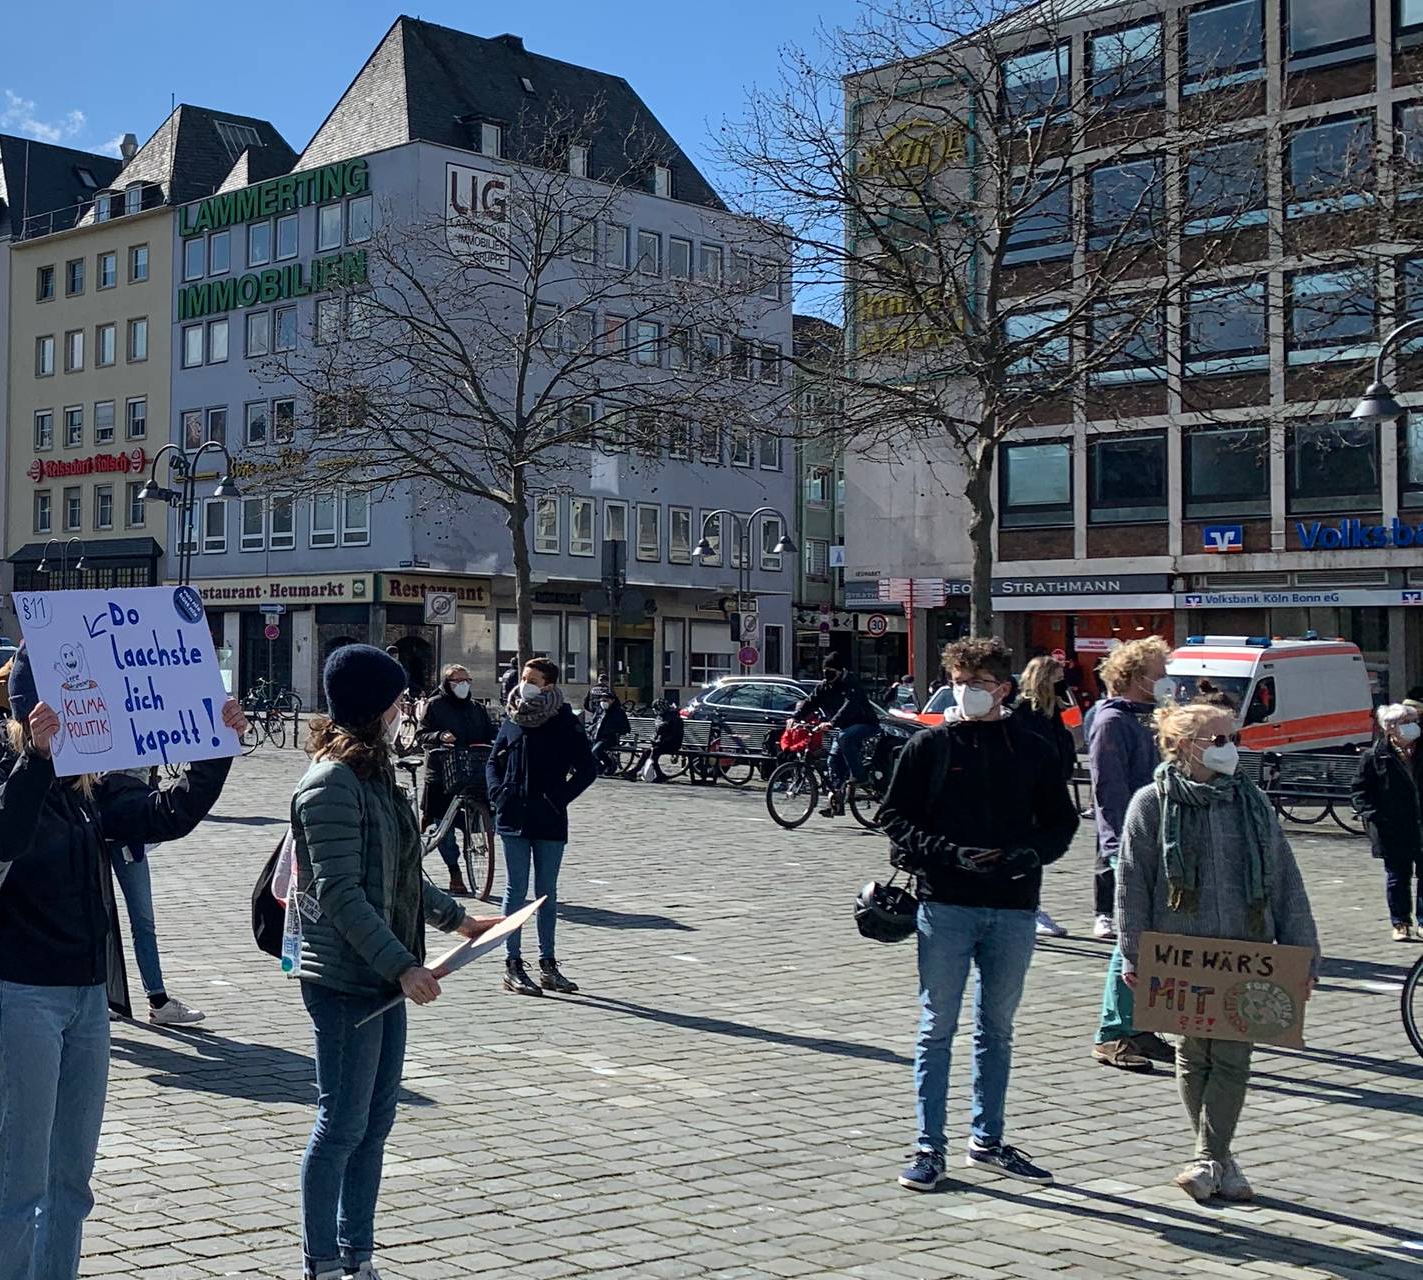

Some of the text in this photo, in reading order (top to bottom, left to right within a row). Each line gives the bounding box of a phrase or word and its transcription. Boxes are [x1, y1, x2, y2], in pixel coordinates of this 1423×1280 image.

[179, 159, 369, 236] LAMMERTING
[451, 171, 506, 222] LIG
[178, 250, 367, 320] IMMOBILIEN
[199, 582, 345, 600] staurant Heumarkt
[1002, 581, 1121, 593] STRATHMANN
[1205, 592, 1339, 604] Volksbank Köln Bonn eG
[108, 602, 139, 626] Do
[110, 629, 202, 670] laachste
[64, 697, 106, 717] KLIMA
[124, 675, 165, 712] dich
[67, 720, 110, 738] POLITIK
[1155, 944, 1274, 976] WIE WÄR'S
